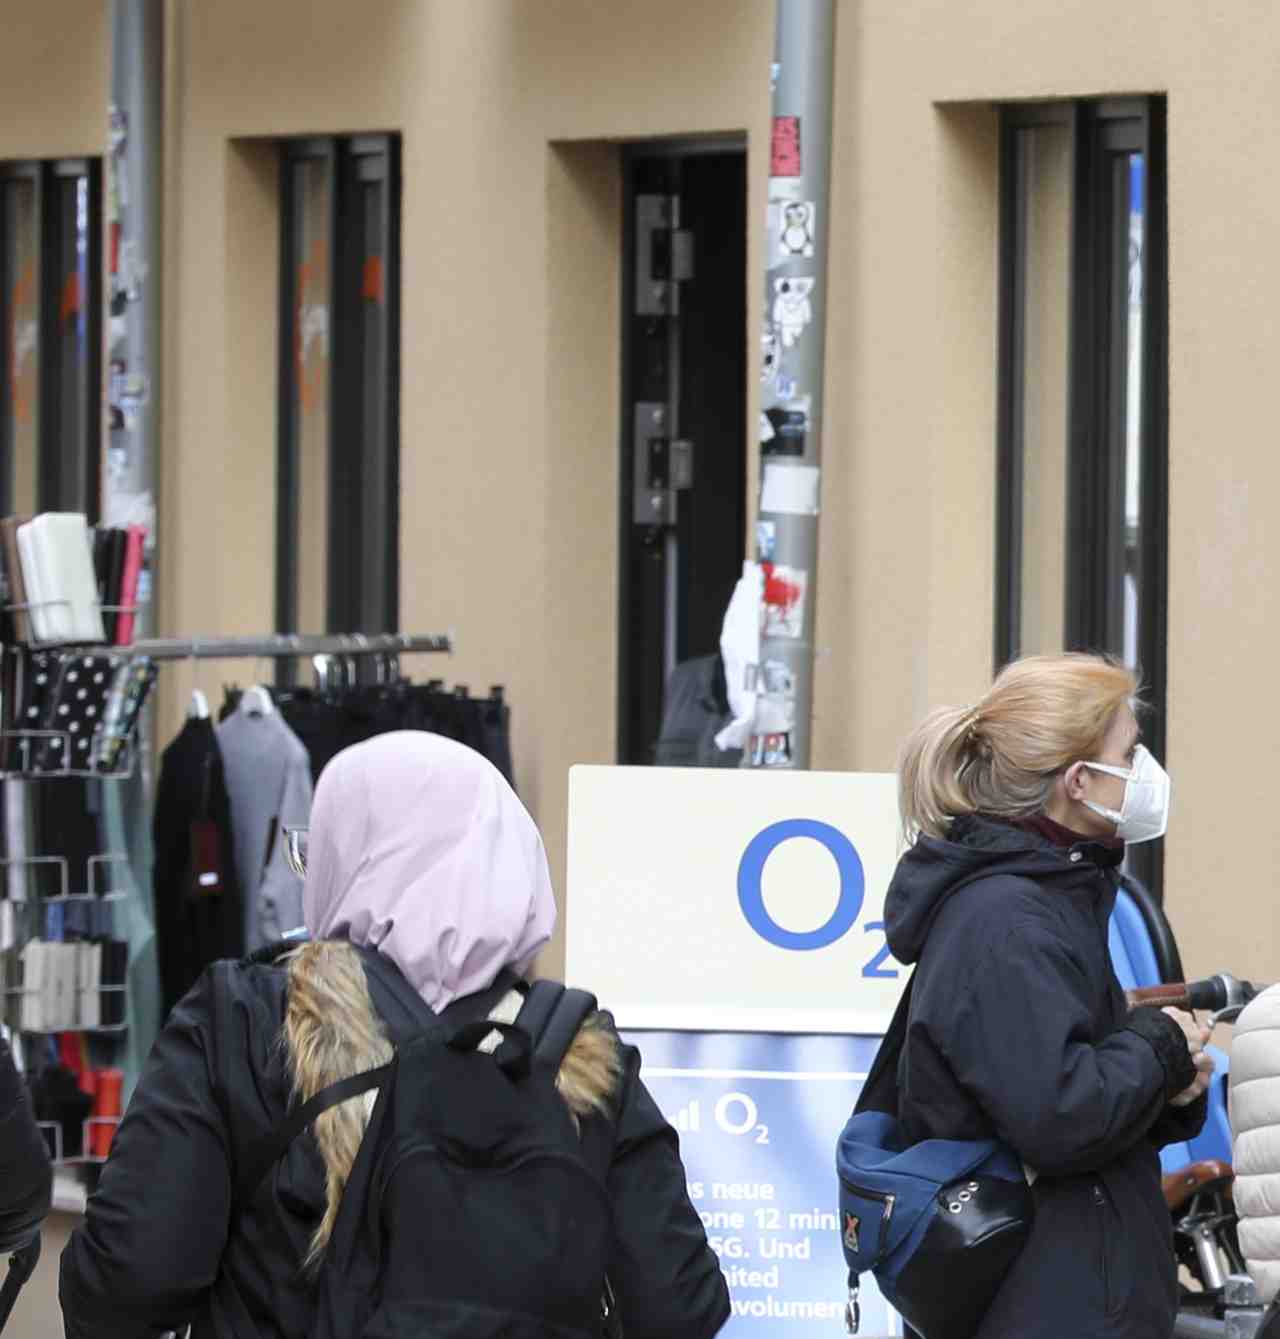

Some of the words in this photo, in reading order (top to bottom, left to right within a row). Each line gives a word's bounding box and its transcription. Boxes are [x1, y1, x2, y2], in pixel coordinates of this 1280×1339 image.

[737, 818, 899, 978] O2
[714, 1091, 770, 1144] O2
[712, 1183, 775, 1200] neue
[700, 1210, 745, 1230] one
[754, 1208, 783, 1230] 12
[759, 1237, 811, 1260] Und
